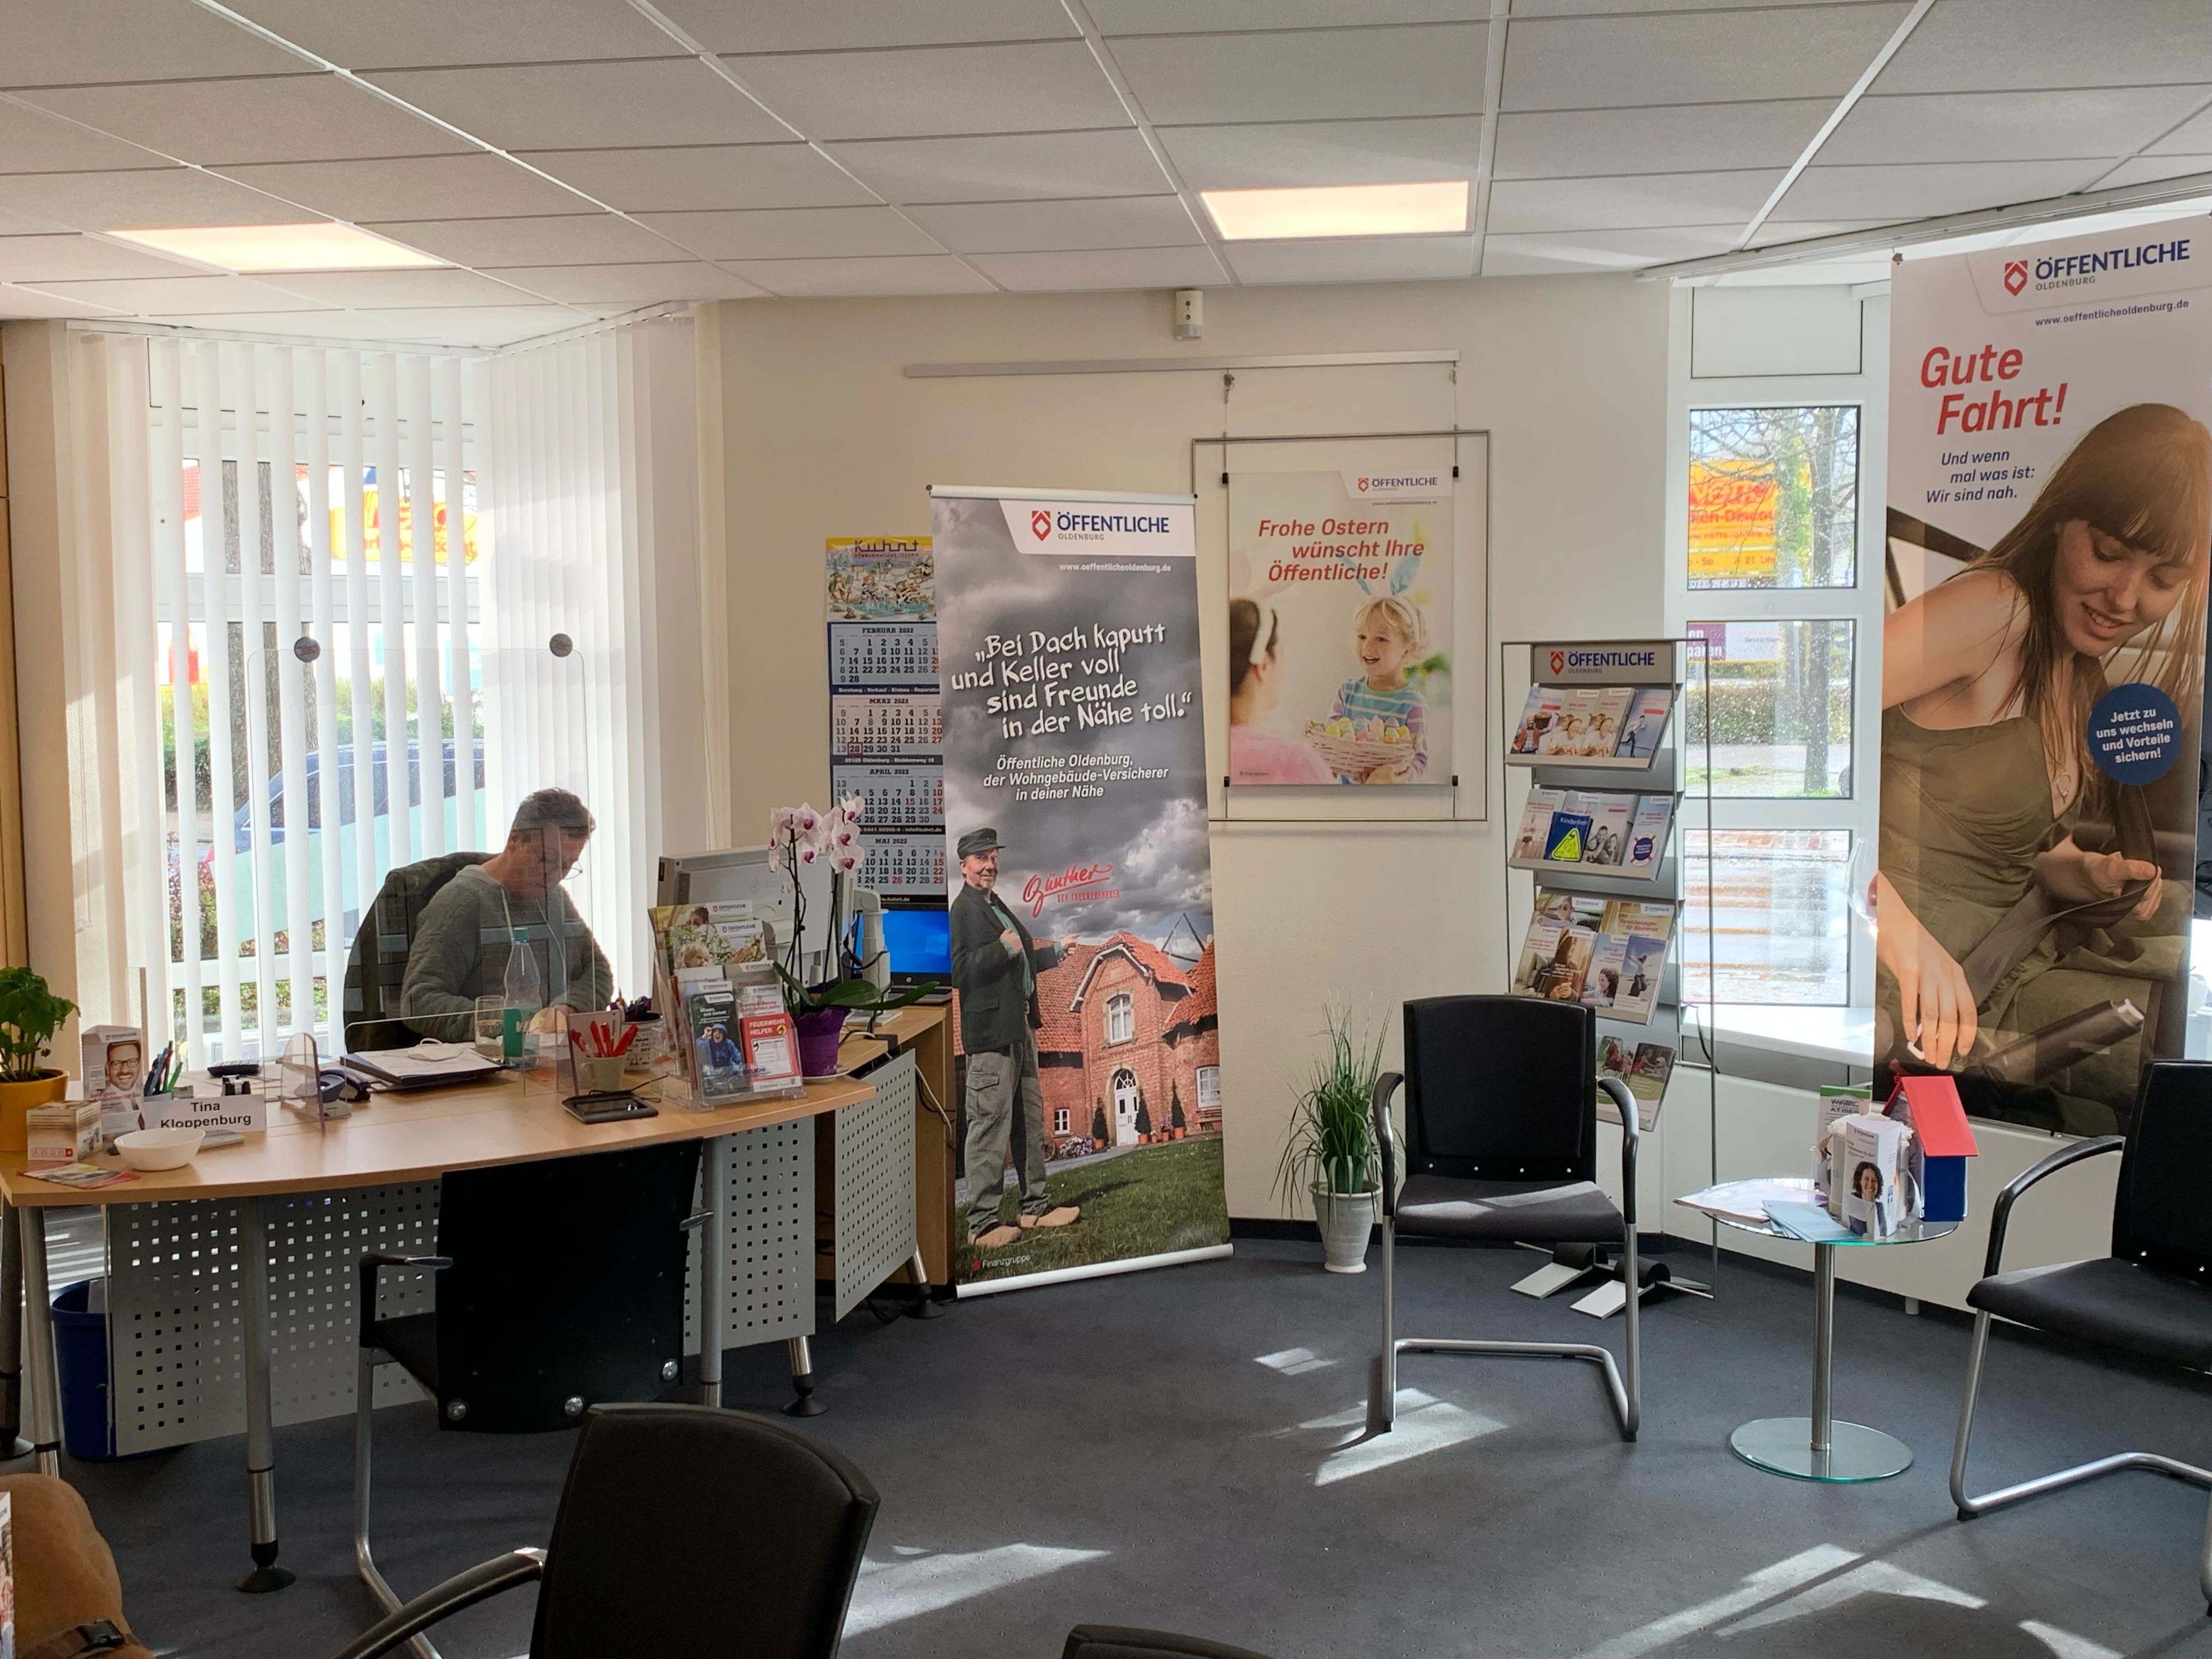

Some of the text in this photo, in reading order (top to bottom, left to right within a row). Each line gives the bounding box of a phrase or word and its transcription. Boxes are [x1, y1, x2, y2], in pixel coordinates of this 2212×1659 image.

[2035, 239, 2191, 279] ÖFFENTLICHE
[2035, 276, 2096, 291] OLDENBURG
[2035, 300, 2189, 326] www.oeffentlicheoldenburg.de
[1921, 344, 2023, 388] Gute
[1937, 383, 2068, 435] Fahrt!
[1942, 450, 2009, 465] Und wenn
[1372, 477, 1437, 487] ÖFFENTLICHE
[1950, 467, 2035, 483] mal was ist:
[1926, 486, 2017, 503] Wir sind nah.
[1058, 512, 1169, 533] ÖFFENTLICHE
[1259, 518, 1389, 537] Frohe Ostern
[855, 540, 919, 552] Kuhnt
[1293, 539, 1424, 558] wünscht Ihre
[1059, 562, 1171, 572] www.oeffentlicheoldenburg.de
[1268, 560, 1387, 582] Öffentliche!
[1029, 626, 1087, 653] Dach
[1094, 623, 1165, 653] kaputt
[1568, 651, 1655, 667] ÖFFENTLICHE
[951, 647, 1120, 690] und Keller voll
[986, 674, 1138, 714] sind Freunde
[933, 718, 944, 726] 13
[1002, 717, 1023, 739] in
[1031, 710, 1070, 735] der
[1077, 702, 1133, 729] Nähe
[2111, 709, 2156, 723] Jetzt zu
[932, 726, 943, 735] 20
[2096, 719, 2173, 738] uns wechseln
[2102, 733, 2170, 751] und Vorteile
[997, 754, 1133, 770] Öffentliche Oldenburg,
[2115, 748, 2161, 763] sichern!
[984, 768, 1169, 787] der Wohngebäude-Versicherer
[1015, 785, 1104, 800] in deiner Nähe
[1023, 864, 1113, 918] Günther
[749, 1018, 786, 1028] FEUERWEHR
[191, 1102, 221, 1113] Tina
[983, 1255, 1030, 1268] Finanzgruppe
